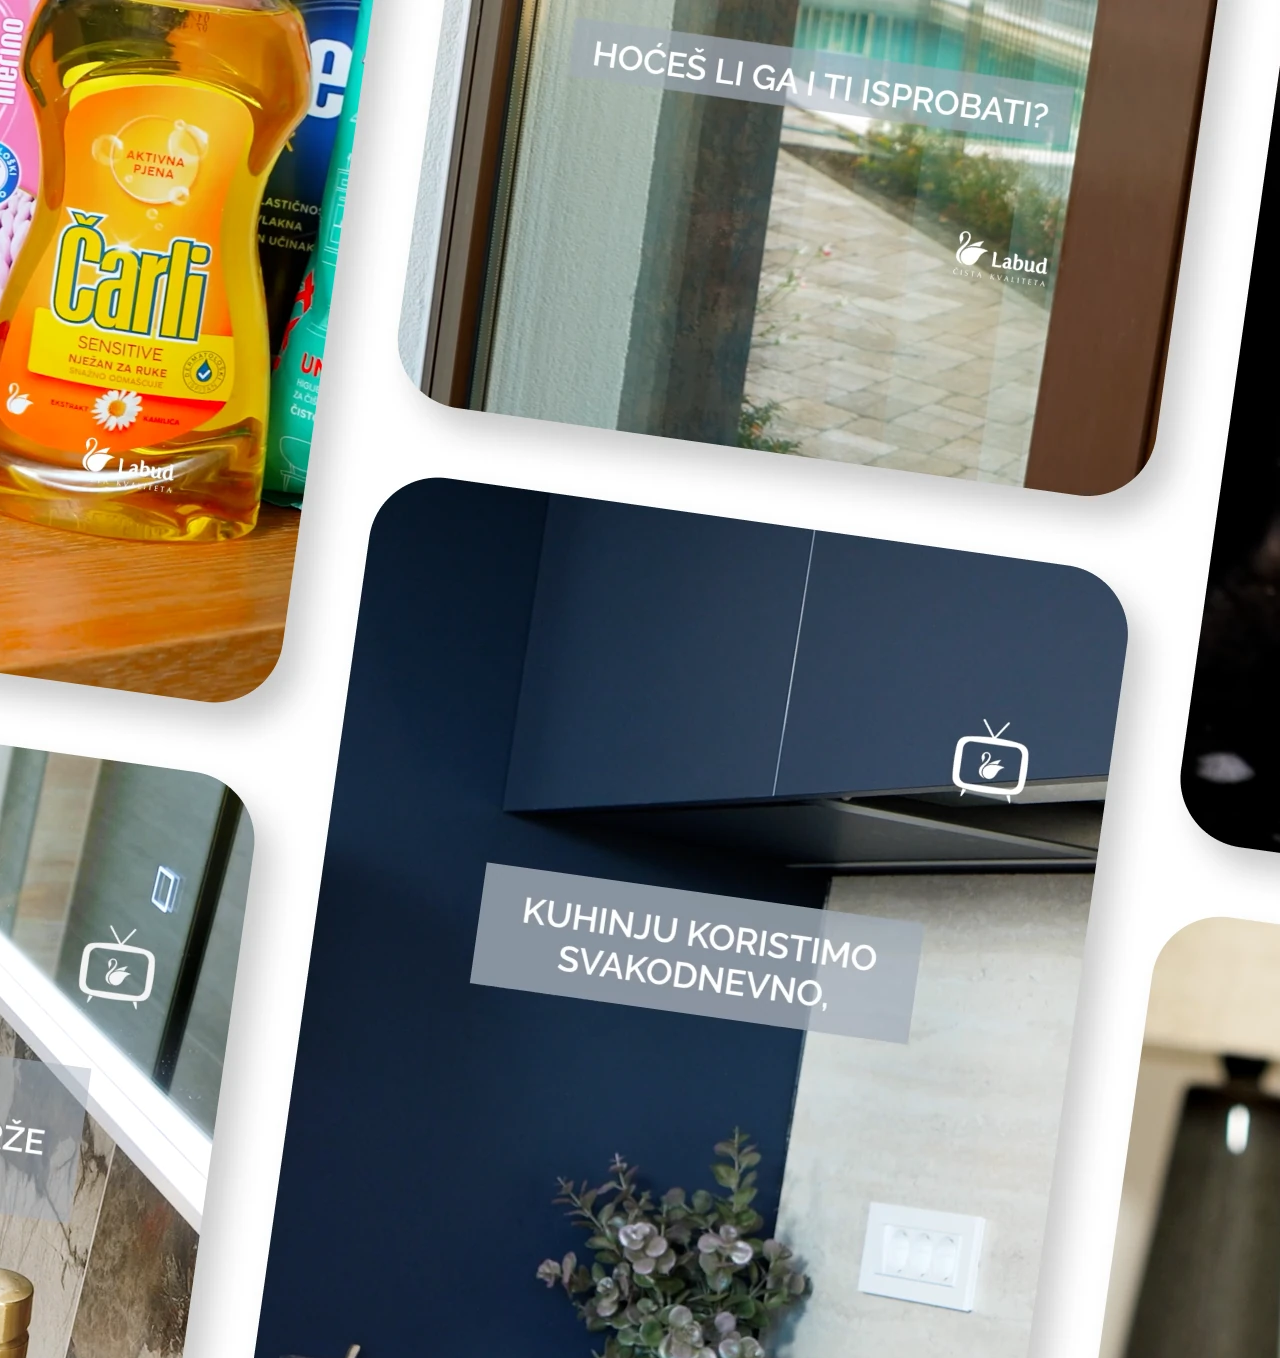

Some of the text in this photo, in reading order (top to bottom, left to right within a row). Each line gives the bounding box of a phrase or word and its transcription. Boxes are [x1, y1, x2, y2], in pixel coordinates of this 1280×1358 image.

[126, 150, 185, 168] AKTIVNA
[133, 164, 174, 179] PJENA
[51, 207, 211, 344] Čarli
[78, 335, 163, 362] SENSITIVE
[68, 353, 167, 378] NJEŽAN ZA RUKE
